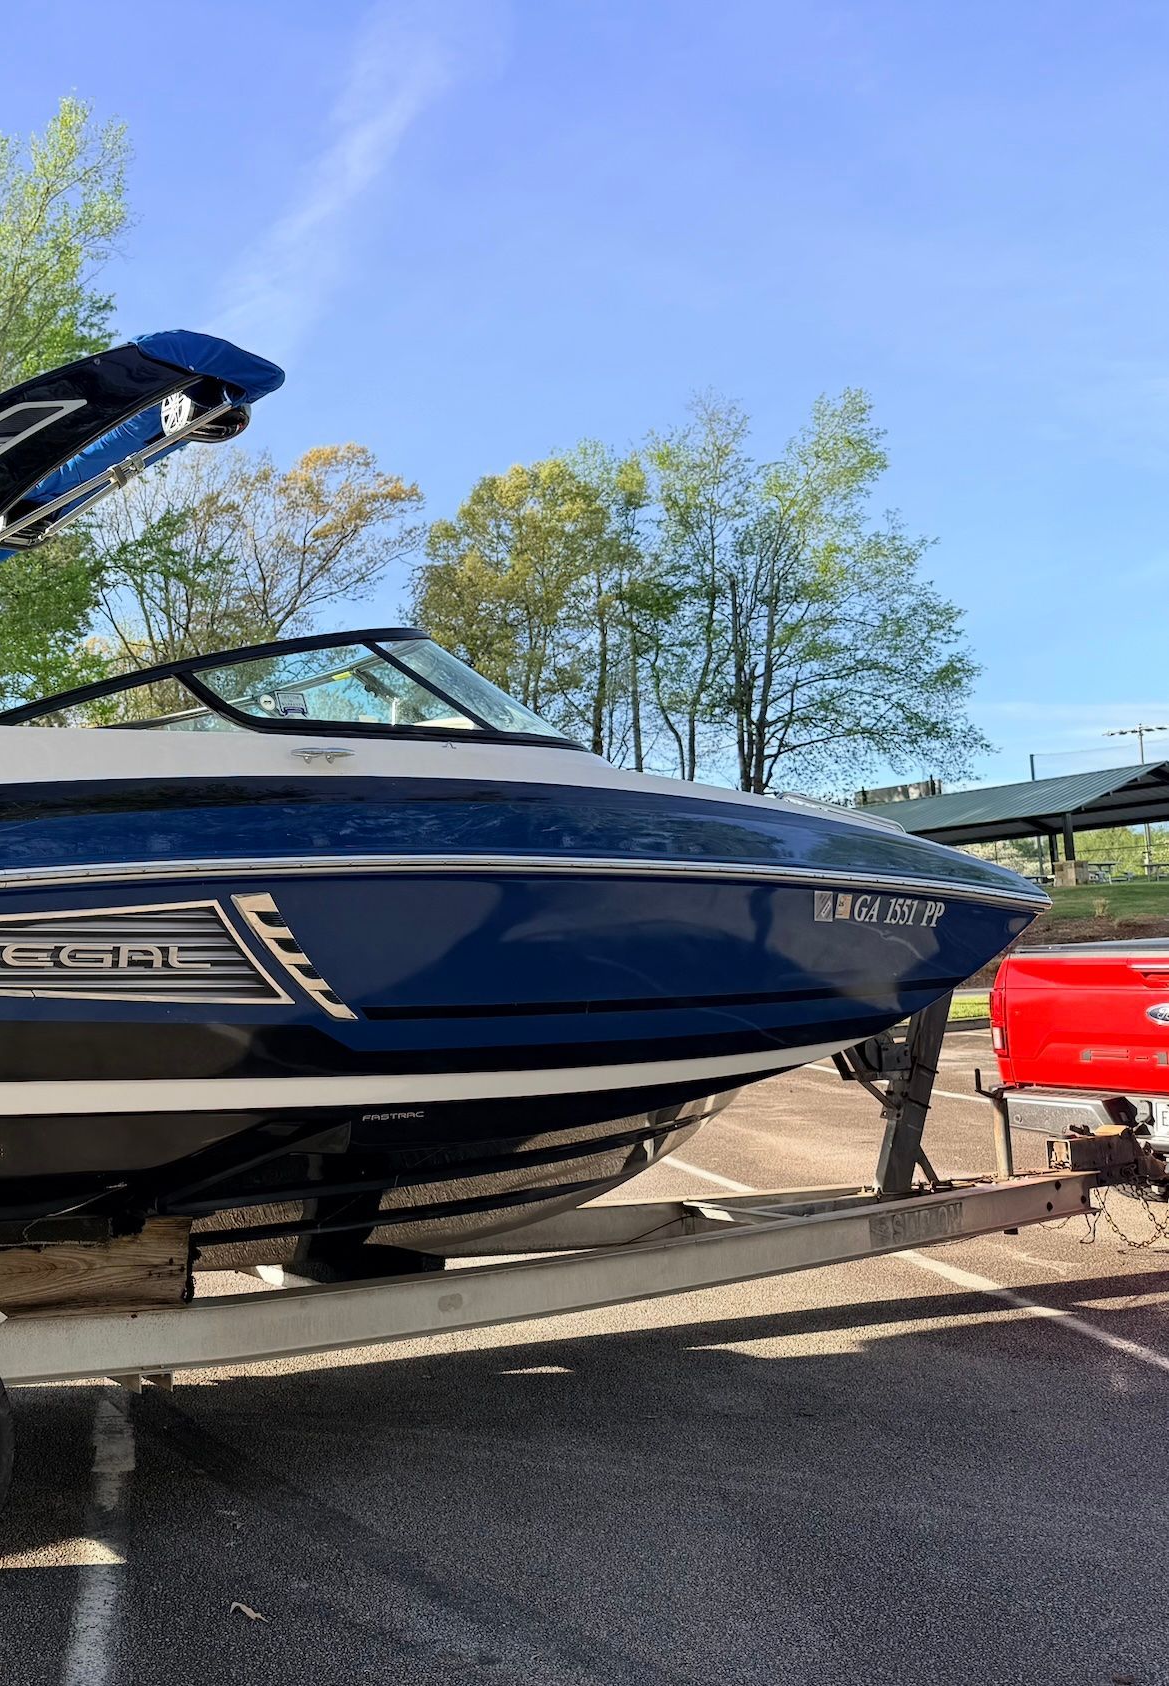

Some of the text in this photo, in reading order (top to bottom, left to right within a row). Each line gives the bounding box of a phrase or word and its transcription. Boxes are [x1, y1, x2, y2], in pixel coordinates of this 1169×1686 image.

[853, 895, 881, 923] GA
[883, 898, 919, 926] 1551
[920, 901, 945, 928] PP
[362, 1111, 424, 1121] FASTRAC
